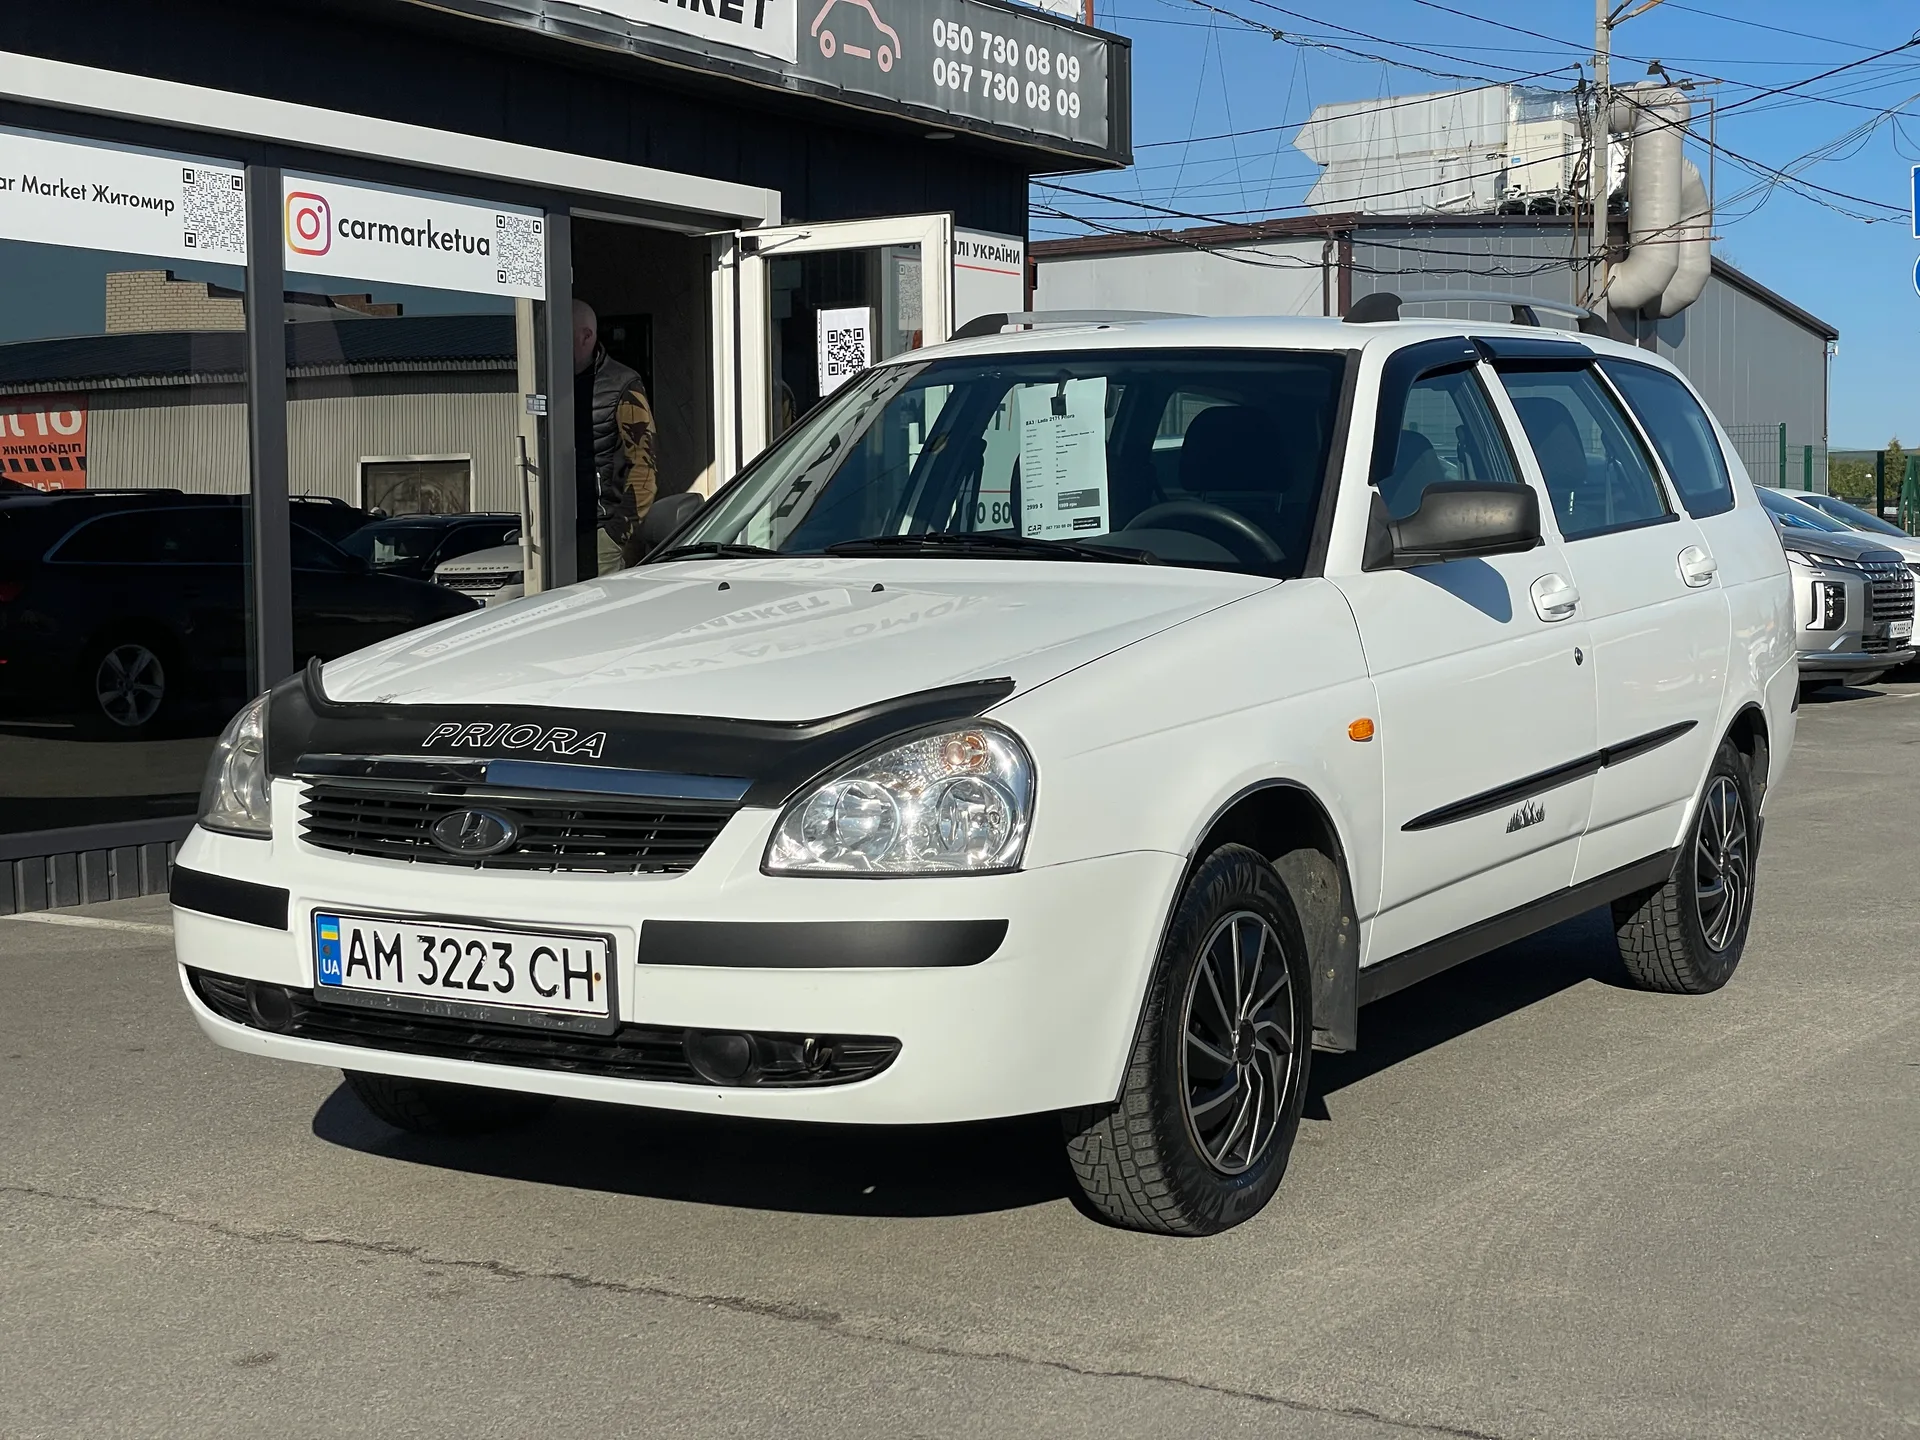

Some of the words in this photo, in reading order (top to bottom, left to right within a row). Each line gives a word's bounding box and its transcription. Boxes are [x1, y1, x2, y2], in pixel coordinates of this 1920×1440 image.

[932, 18, 974, 55] 050
[980, 30, 1019, 67] 730
[1025, 43, 1050, 75] 08
[1056, 52, 1080, 83] 09
[932, 57, 973, 93] 067
[980, 68, 1019, 104] 730
[1025, 80, 1051, 112] 08
[1056, 88, 1081, 119] 09
[21, 174, 87, 201] Market
[91, 183, 175, 217] Житомир
[338, 218, 490, 256] carmarketua
[972, 243, 1020, 265] УКРАЇНИ
[422, 722, 607, 758] PRIORA
[322, 959, 340, 976] UA
[346, 928, 403, 983] AM
[416, 934, 515, 994] 3223
[529, 946, 594, 1002] CH
